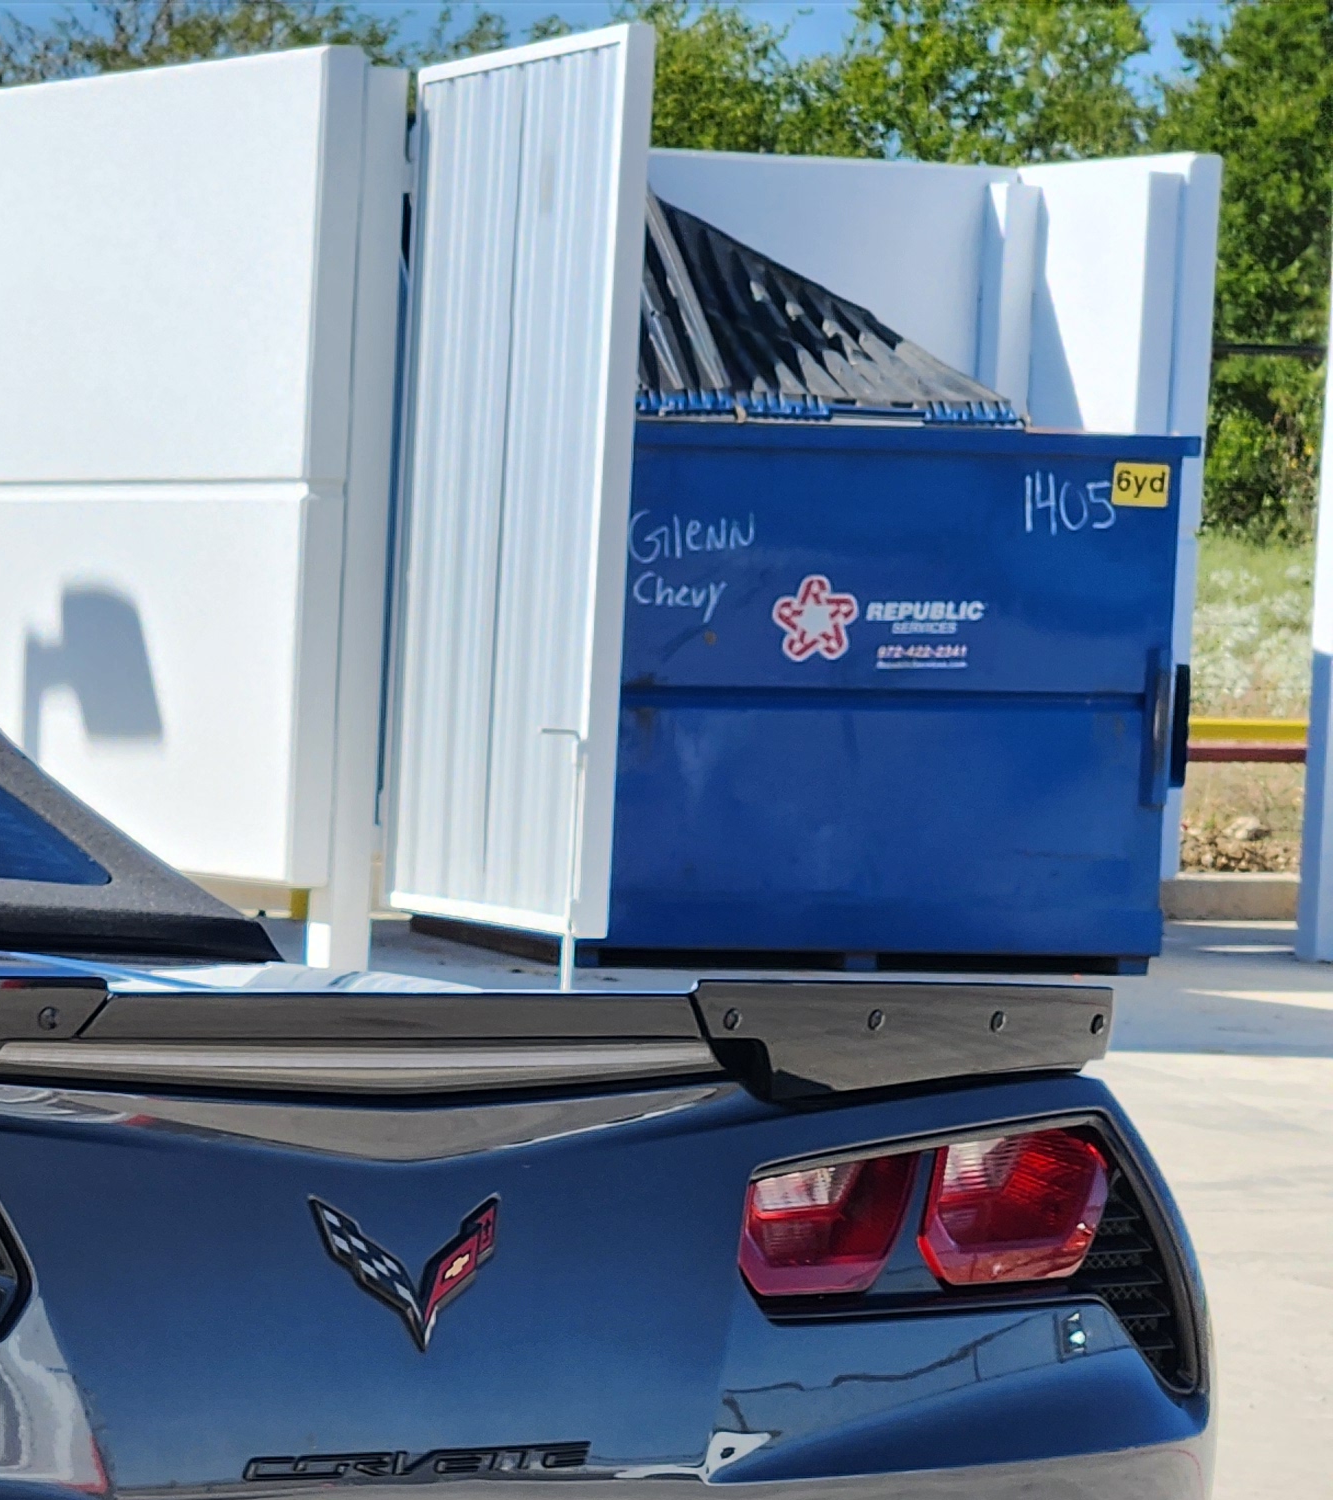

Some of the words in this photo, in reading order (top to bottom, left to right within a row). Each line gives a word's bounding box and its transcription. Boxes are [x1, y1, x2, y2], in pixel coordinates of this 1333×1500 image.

[1117, 470, 1166, 498] 6yd
[1025, 469, 1117, 536] 1405
[633, 570, 728, 624] Chevy
[866, 601, 985, 622] REPUBLIC
[891, 622, 958, 635] SERVICES
